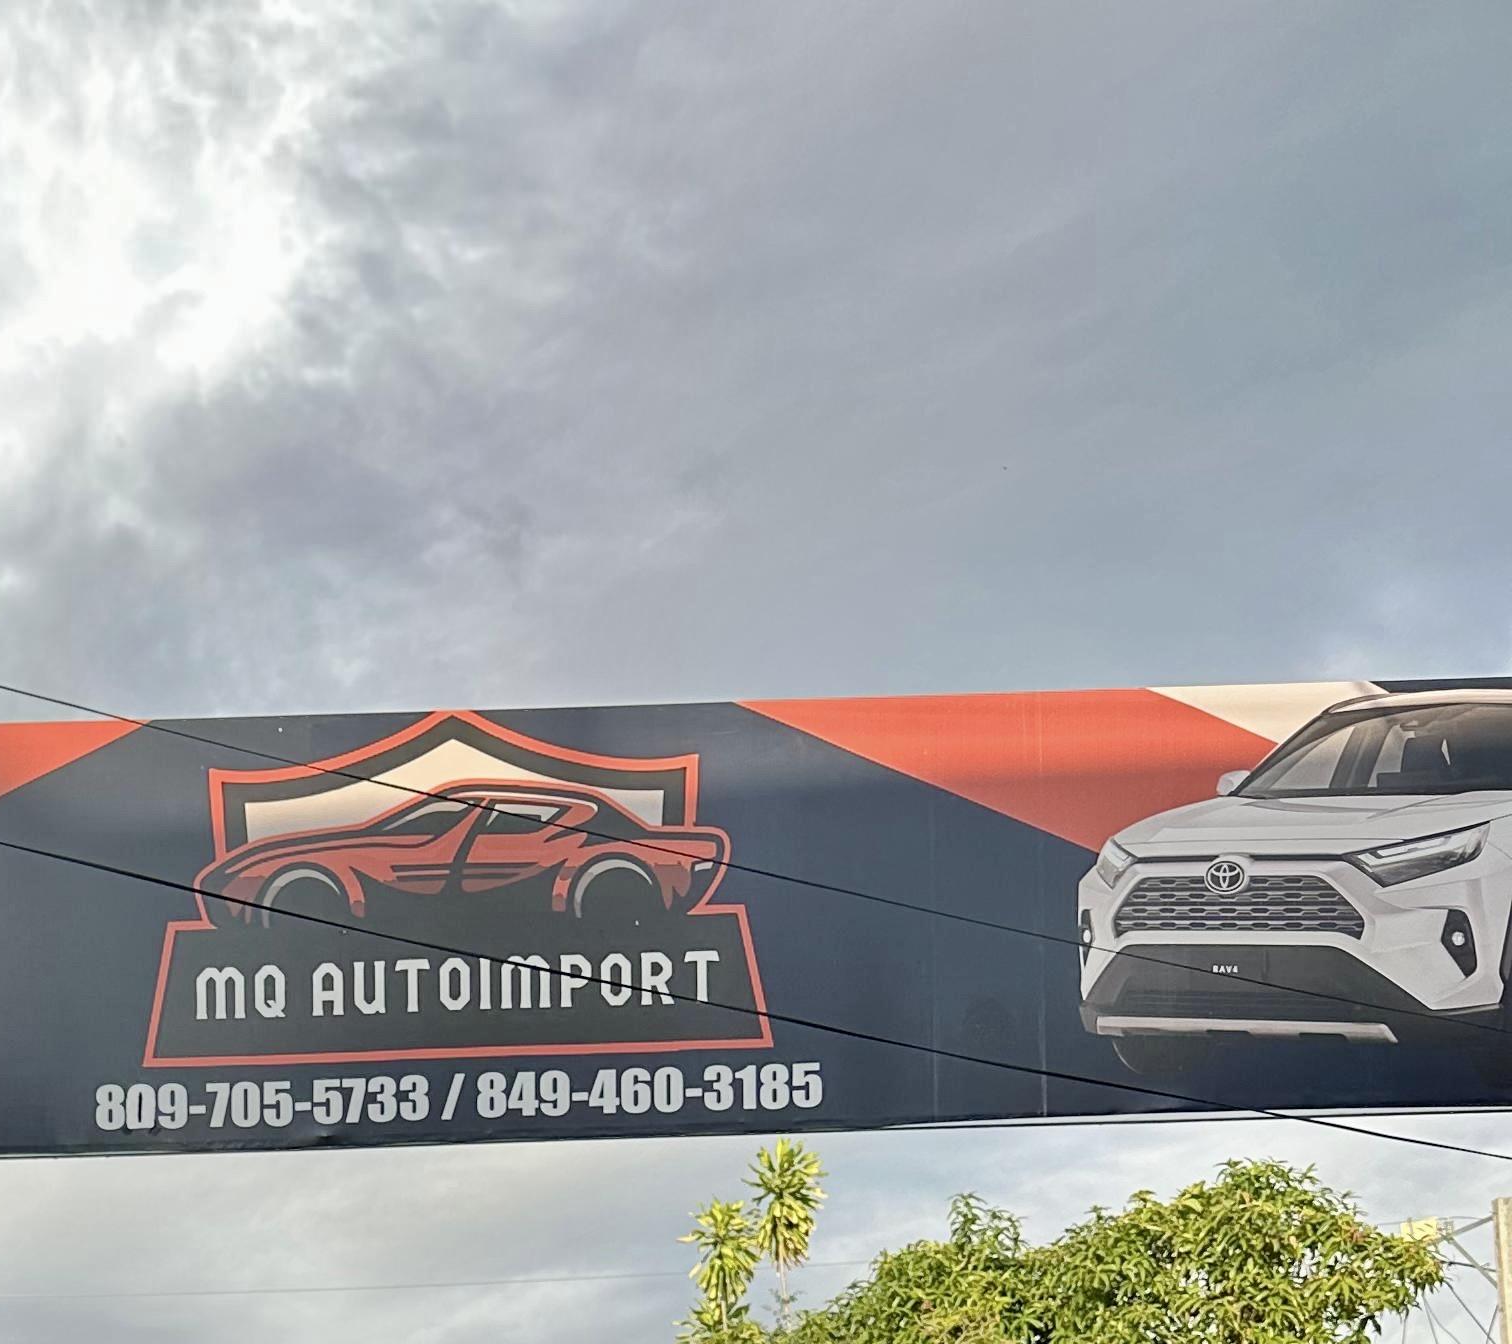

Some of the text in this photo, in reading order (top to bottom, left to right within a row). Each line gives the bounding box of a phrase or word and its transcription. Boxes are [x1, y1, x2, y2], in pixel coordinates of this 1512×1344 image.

[194, 950, 721, 1020] MQ AUTOIMPORT
[94, 1062, 824, 1131] 809-705-5733 / 849-460-3185
